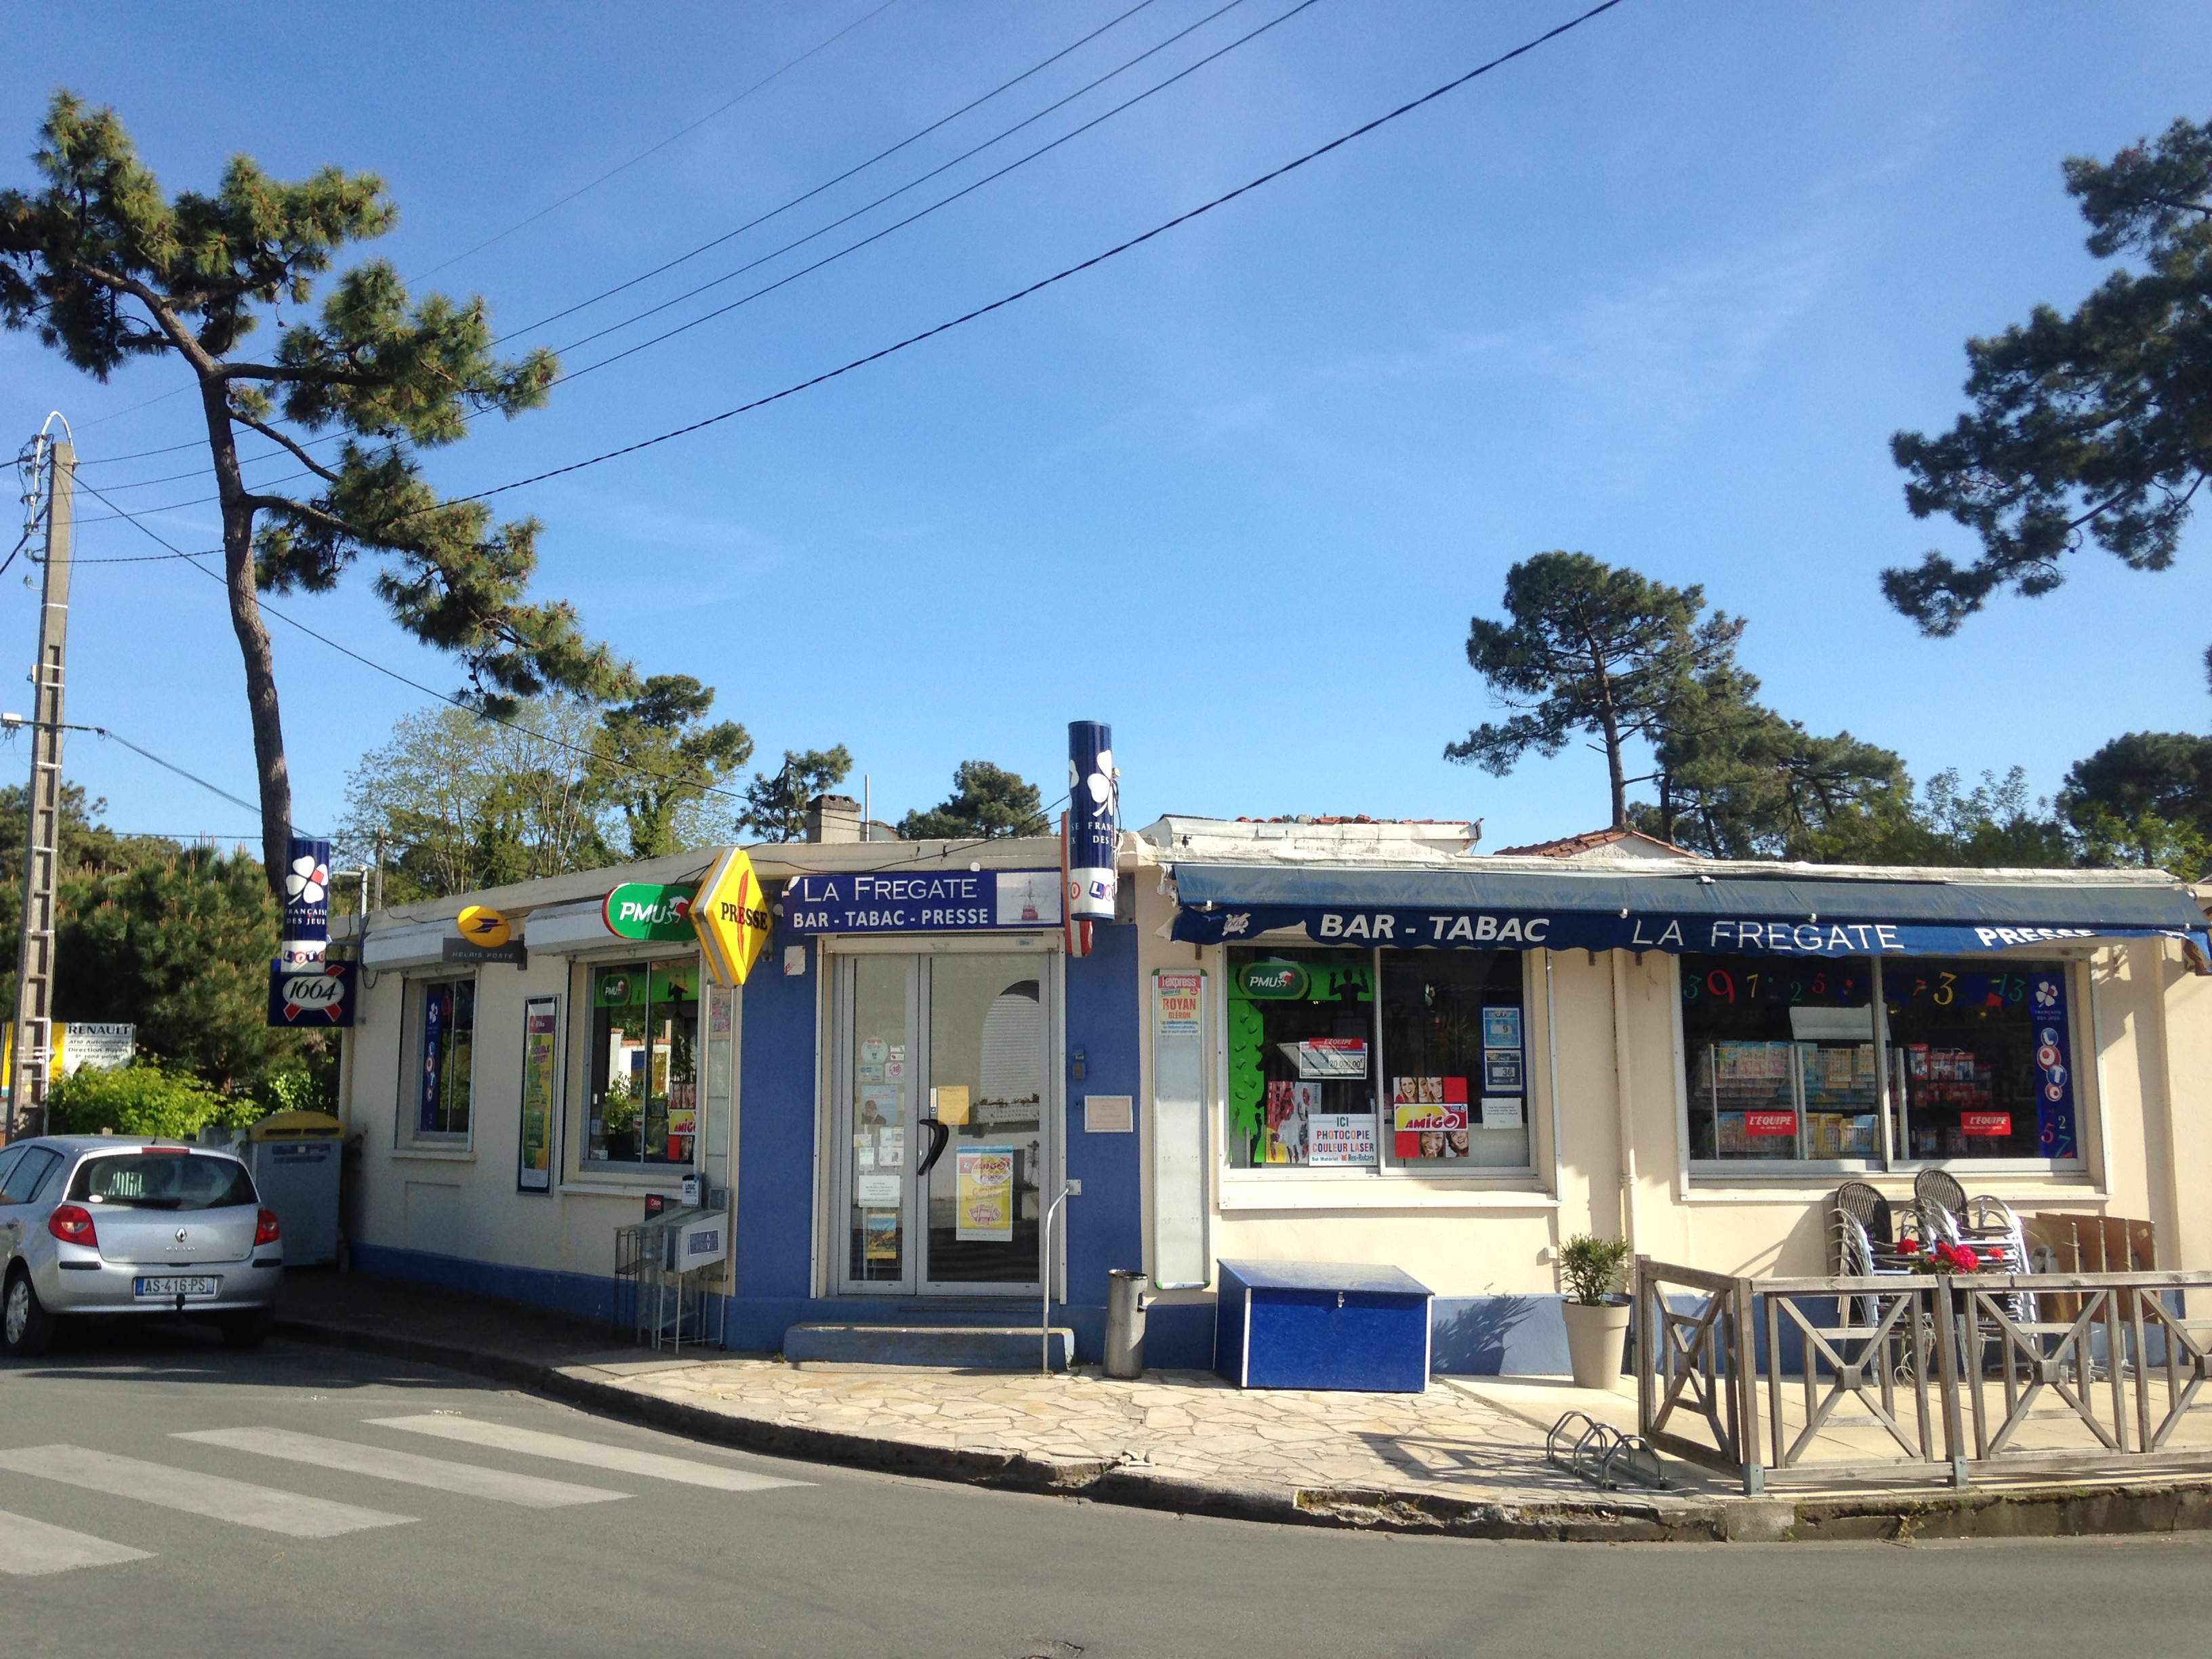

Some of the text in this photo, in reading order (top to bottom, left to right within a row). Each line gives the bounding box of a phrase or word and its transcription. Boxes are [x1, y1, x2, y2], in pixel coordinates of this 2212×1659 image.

[1092, 835, 1109, 844] DES
[804, 876, 977, 902] LA FREGATE
[619, 901, 667, 924] PMU
[720, 901, 768, 931] PRESSE
[794, 912, 828, 928] BAR
[845, 910, 905, 926] TABAC
[922, 908, 988, 925] PRESSE
[1319, 914, 1395, 939] BAR
[1429, 916, 1551, 942] TABAC
[1631, 919, 1905, 950] LA FREGATE
[283, 949, 325, 964] LOTO
[1249, 975, 1279, 987] PMU
[1707, 969, 1736, 1005] 9
[1746, 973, 1759, 998] 7
[1790, 981, 1803, 1002] 2
[1812, 972, 1826, 994] 5
[1933, 970, 1957, 1006] 3
[289, 978, 337, 1001] 1664
[605, 986, 618, 996] PMU
[1162, 998, 1196, 1010] ROYAN
[68, 1025, 130, 1035] RENAULT
[1502, 1025, 1509, 1033] 9
[1502, 1068, 1513, 1076] 36
[1336, 1116, 1349, 1127] ICI
[1405, 1112, 1460, 1129] AMIGO
[2058, 1115, 2066, 1129] 2
[1316, 1130, 1370, 1140] PHOTOCOPIE
[2041, 1123, 2055, 1143] 5
[1312, 1143, 1374, 1153] COULEUR LASER
[144, 1278, 205, 1292] AS-416-PS
